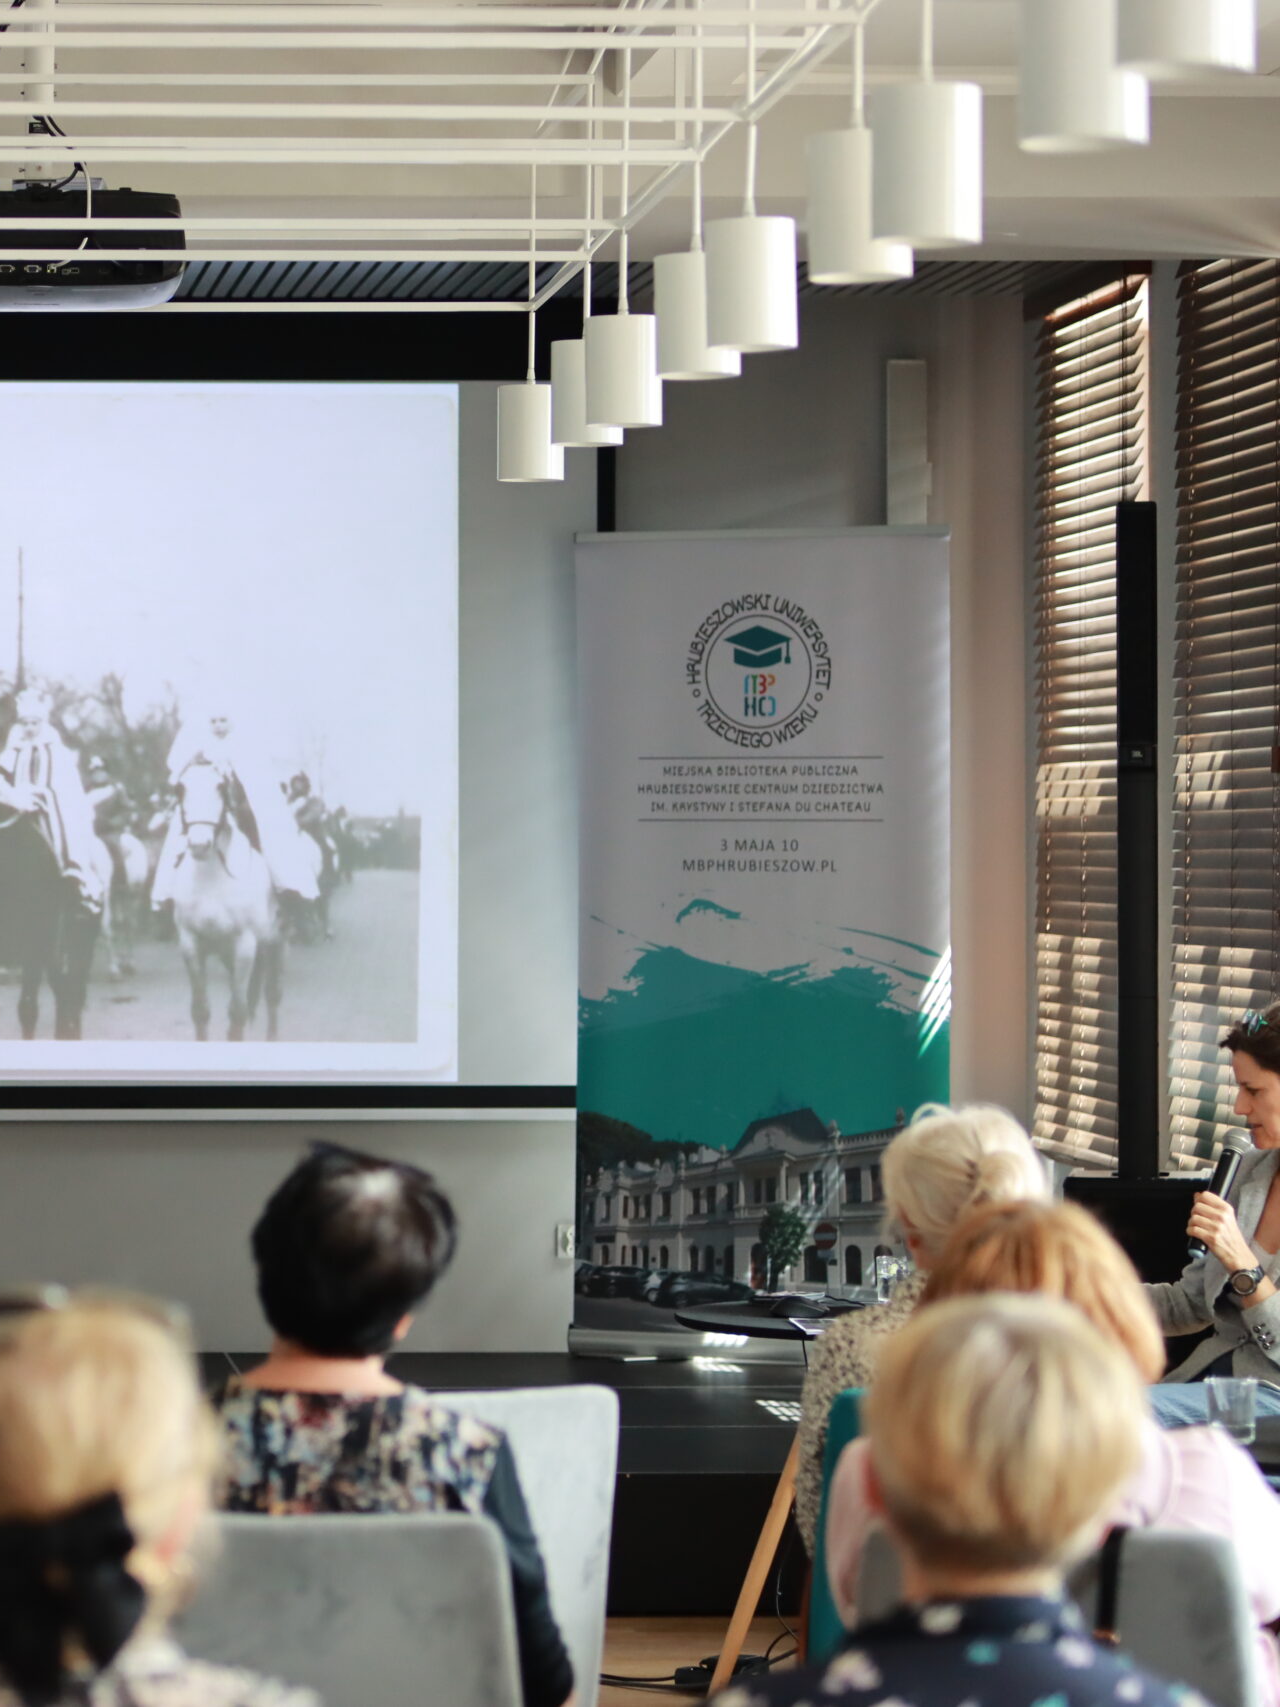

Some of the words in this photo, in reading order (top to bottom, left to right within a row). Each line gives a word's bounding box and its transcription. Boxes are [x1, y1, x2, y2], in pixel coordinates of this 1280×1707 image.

[687, 594, 771, 685] HRUBIESZOWSKI
[774, 596, 831, 690] UNIWERSYTET
[697, 699, 772, 748] TRZECIEGO
[773, 703, 818, 744] WIEKU
[664, 766, 712, 776] MIEJSKA
[717, 766, 787, 776] BIBLIOTEKA
[792, 765, 858, 776] PUBLICZNA
[638, 784, 739, 794] HRUBIESZOWSKIE
[744, 784, 798, 794] CENTRUM
[803, 784, 883, 794] DZIEDZICTWA
[651, 802, 667, 813] IM.
[672, 802, 725, 812] KRYSTYNY
[738, 802, 790, 812] STEFANA
[795, 802, 810, 812] DU
[815, 802, 870, 812] CHATEAU
[721, 839, 727, 851] 3
[735, 840, 774, 851] MAJA
[783, 840, 798, 851] 10
[683, 859, 836, 872] MBPHRUBIESZOW.PL
